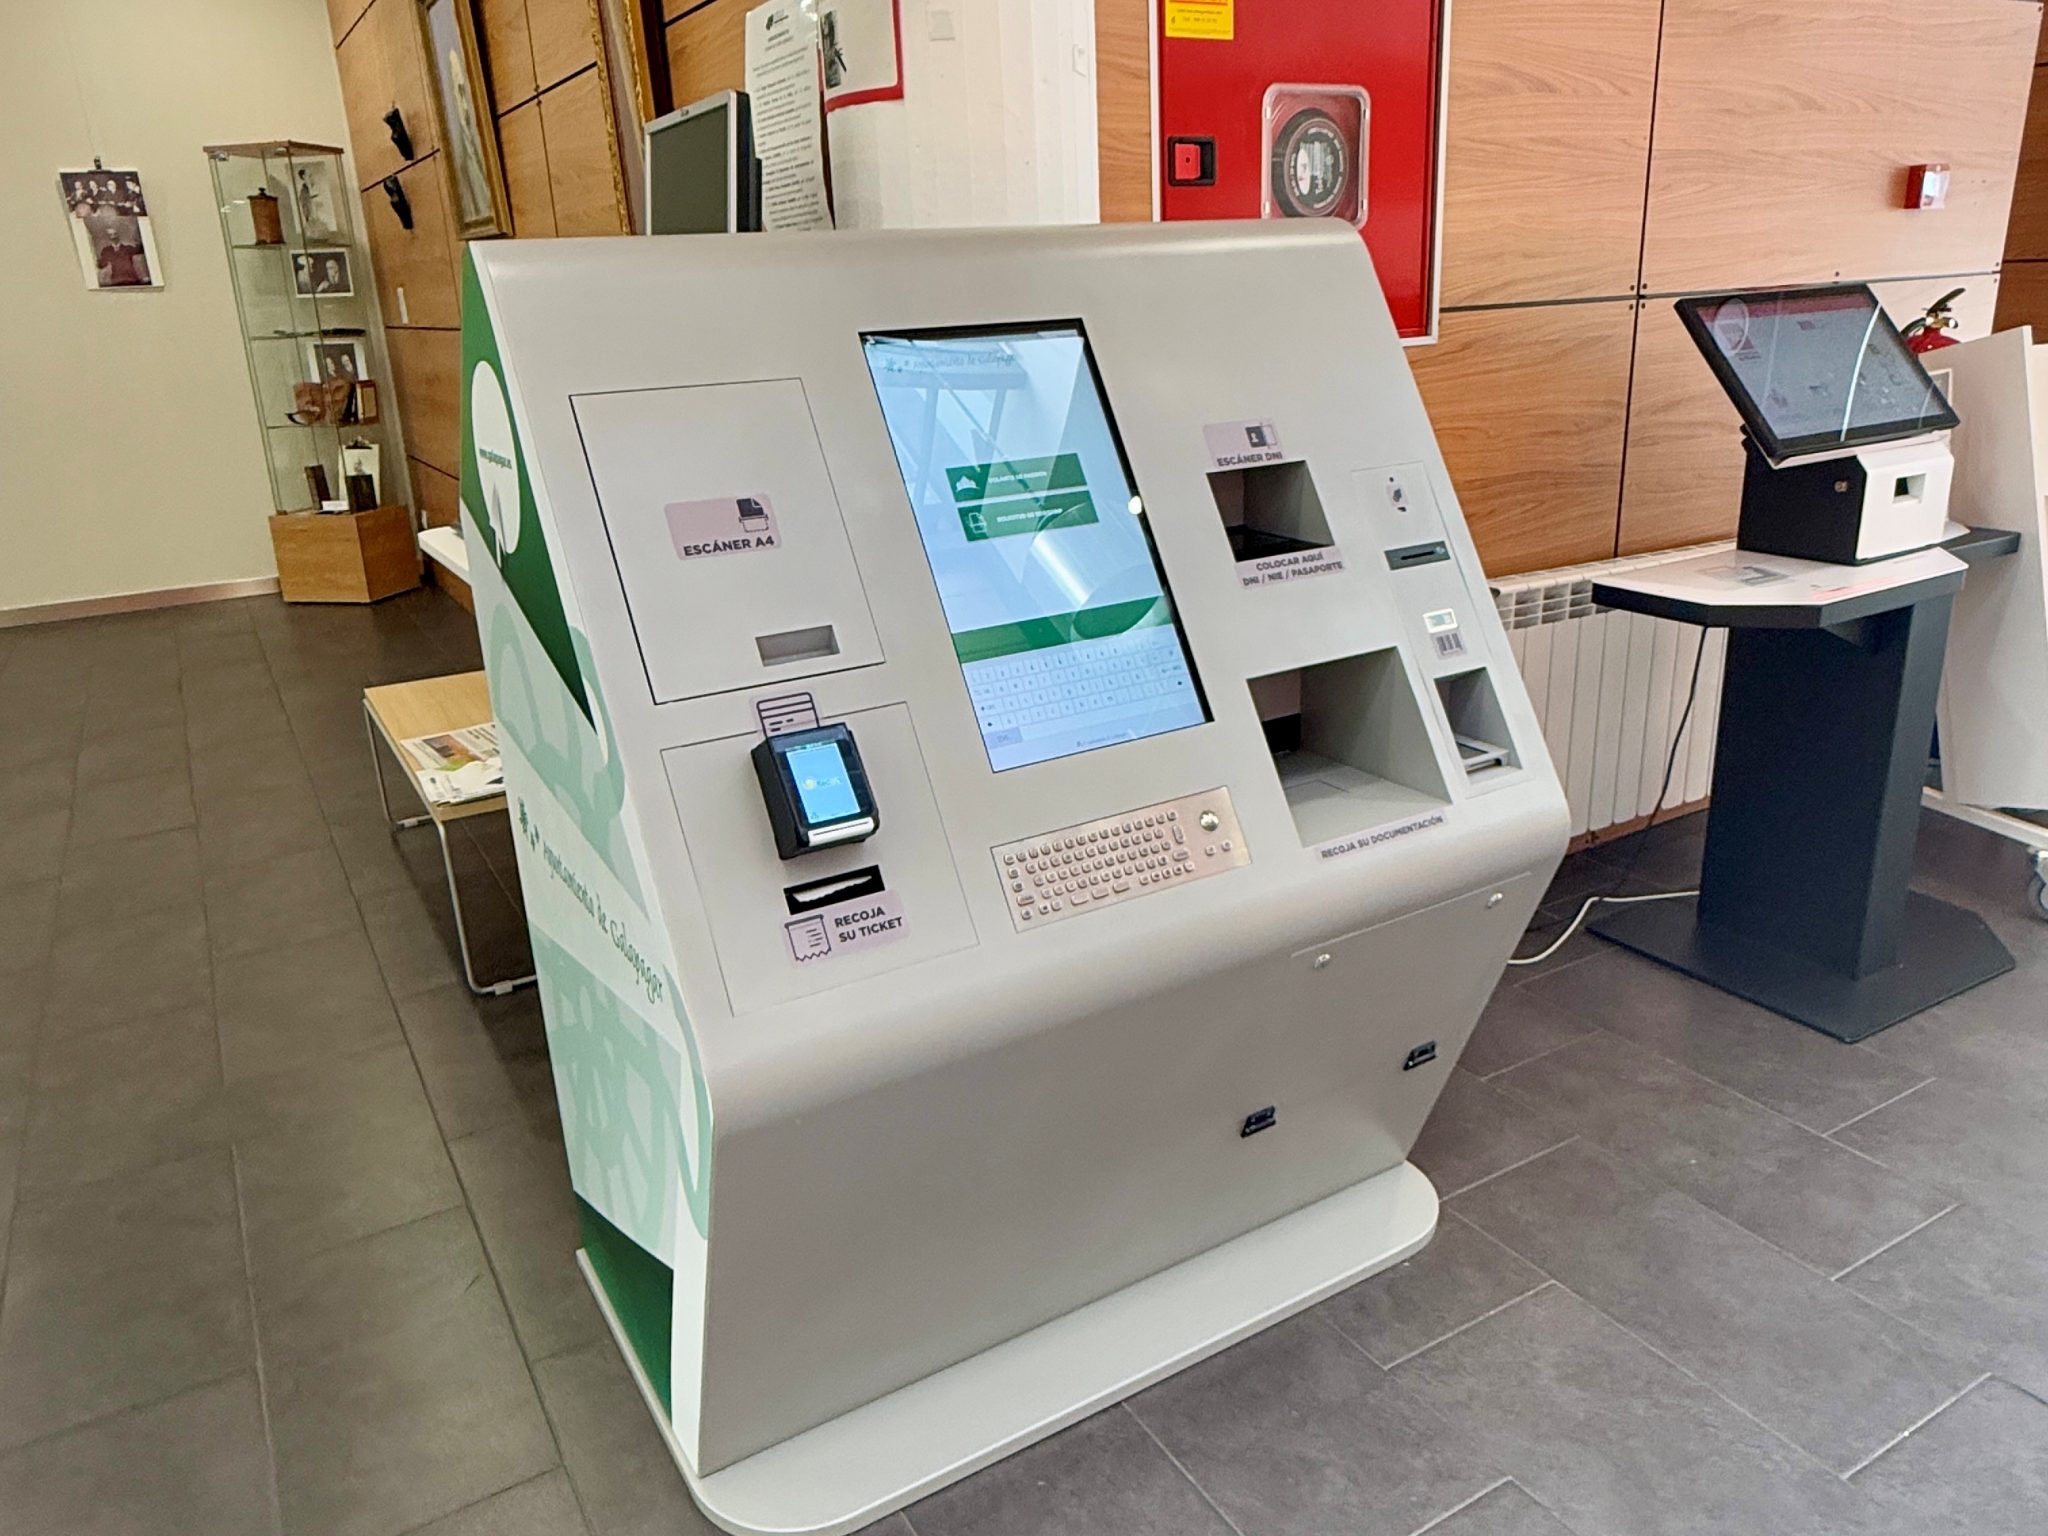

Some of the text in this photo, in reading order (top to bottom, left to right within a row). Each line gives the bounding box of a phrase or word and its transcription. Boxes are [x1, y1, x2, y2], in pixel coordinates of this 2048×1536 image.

[1217, 452, 1283, 466] ESCÁNER DNI
[683, 534, 775, 557] ESCÁNER A4
[1256, 552, 1323, 571] COLOCAR AQUÍ
[1242, 561, 1342, 586] DNI / NIE / PASAPORTE
[1321, 816, 1443, 858] RECOJA SU DOCUMENTACIÓN
[833, 906, 886, 928] RECOJA
[838, 916, 903, 943] SU TICKET
